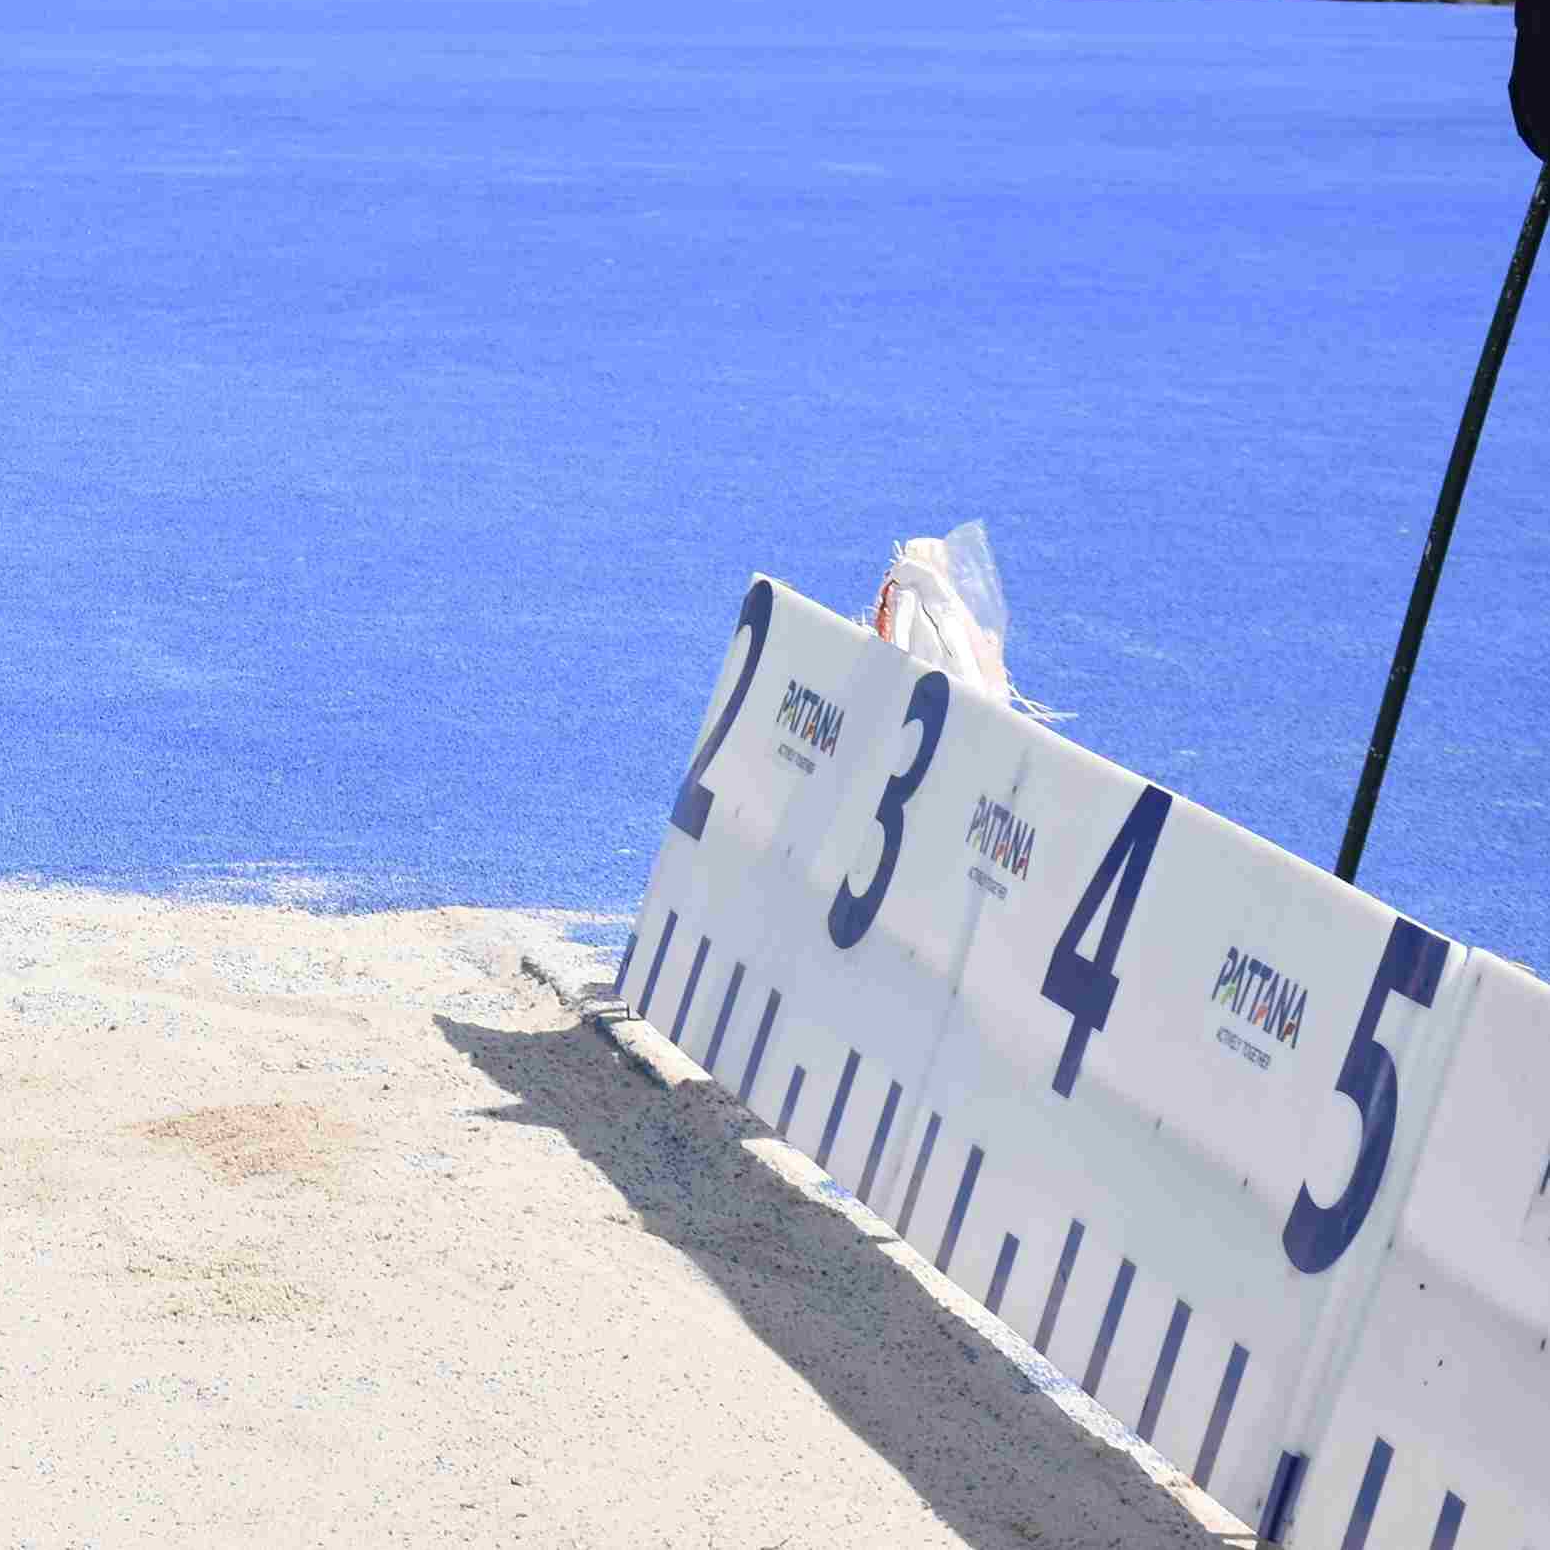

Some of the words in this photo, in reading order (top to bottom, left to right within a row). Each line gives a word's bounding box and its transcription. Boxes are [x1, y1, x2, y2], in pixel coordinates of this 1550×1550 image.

[669, 579, 774, 842] 2
[776, 678, 845, 758] PATTANA
[827, 670, 951, 950] 3
[964, 794, 1036, 882] PATTANA
[1039, 783, 1174, 1100] 4
[1211, 946, 1309, 1050] PATTANA
[1281, 916, 1452, 1275] 5
